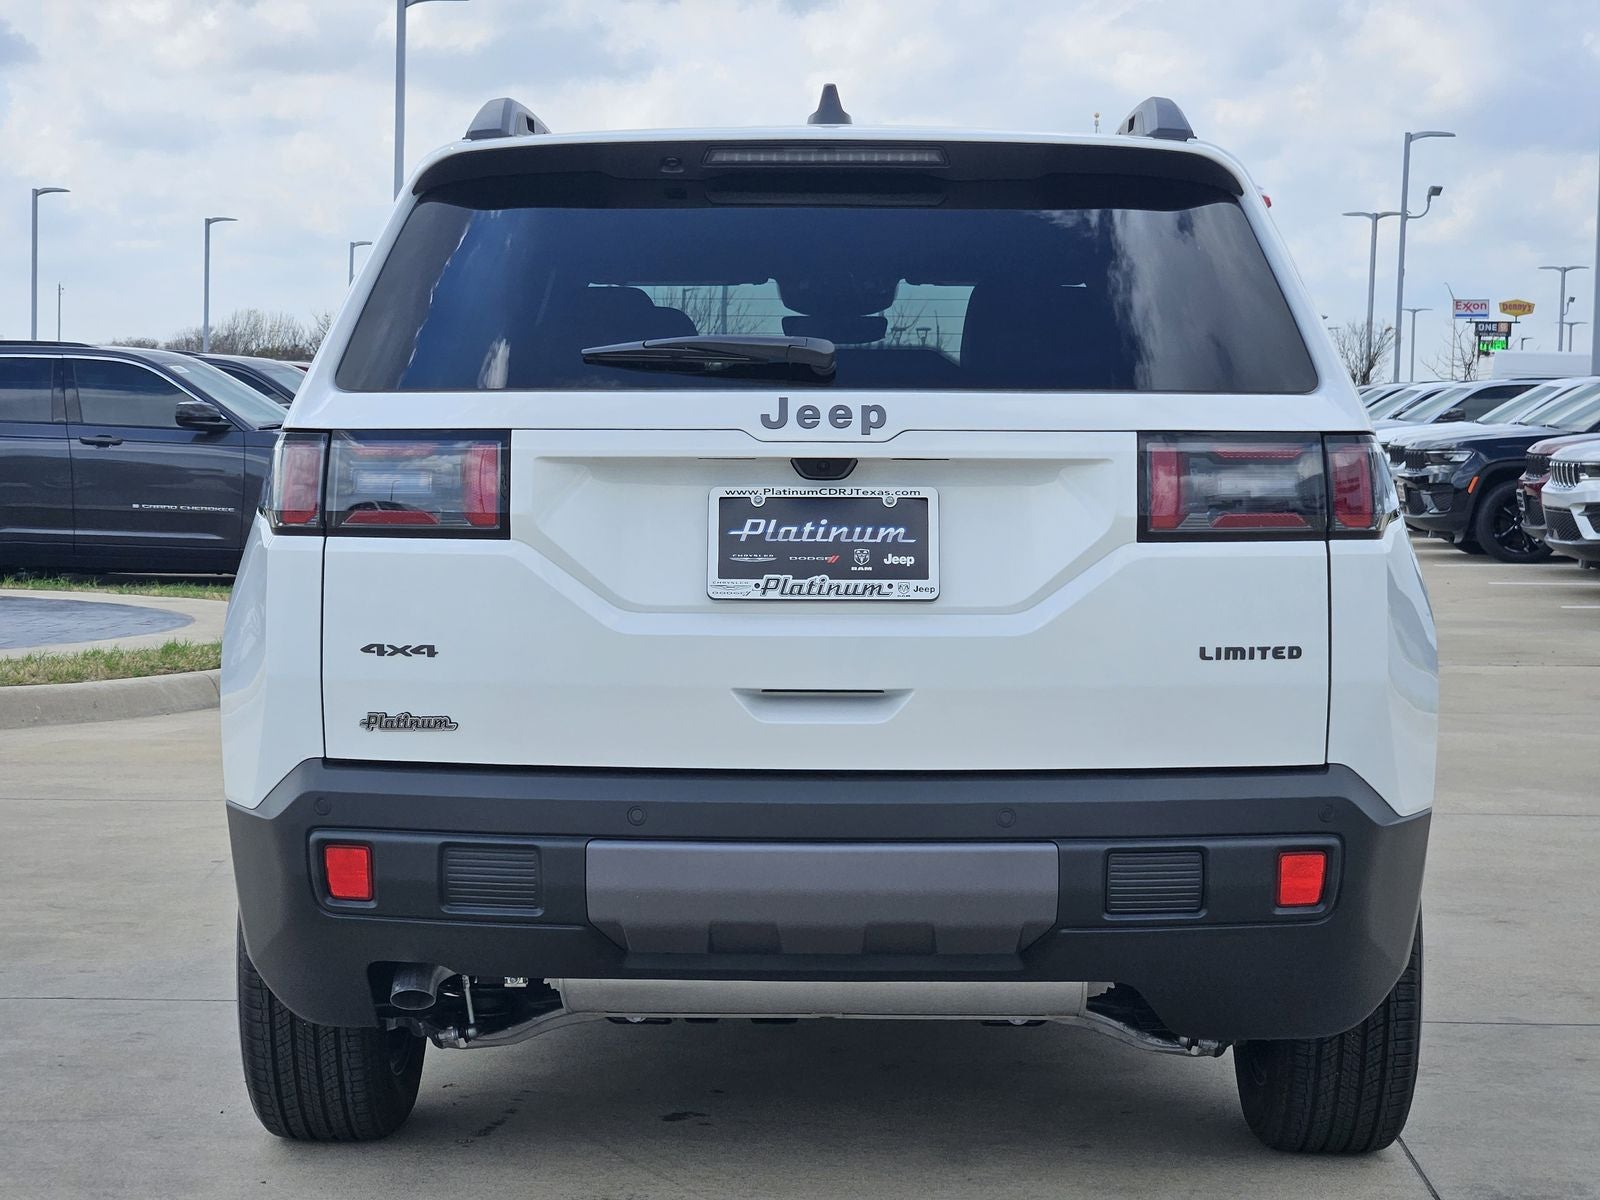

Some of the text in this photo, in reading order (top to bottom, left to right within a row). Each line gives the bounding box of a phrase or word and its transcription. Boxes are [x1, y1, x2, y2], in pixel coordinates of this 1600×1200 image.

[1455, 301, 1487, 313] Exxon
[1502, 303, 1532, 312] Denny's
[1478, 323, 1498, 331] ONE
[760, 397, 887, 435] Jeep
[725, 488, 921, 496] www.PlatinumCDRJTexas.com
[180, 505, 235, 513] CHEROKEE
[727, 518, 917, 543] Platinum
[883, 553, 915, 567] Jeep
[760, 574, 894, 597] Platinum
[913, 585, 936, 594] Jeep
[1199, 645, 1303, 660] LIMITED
[360, 711, 459, 732] Platinum
